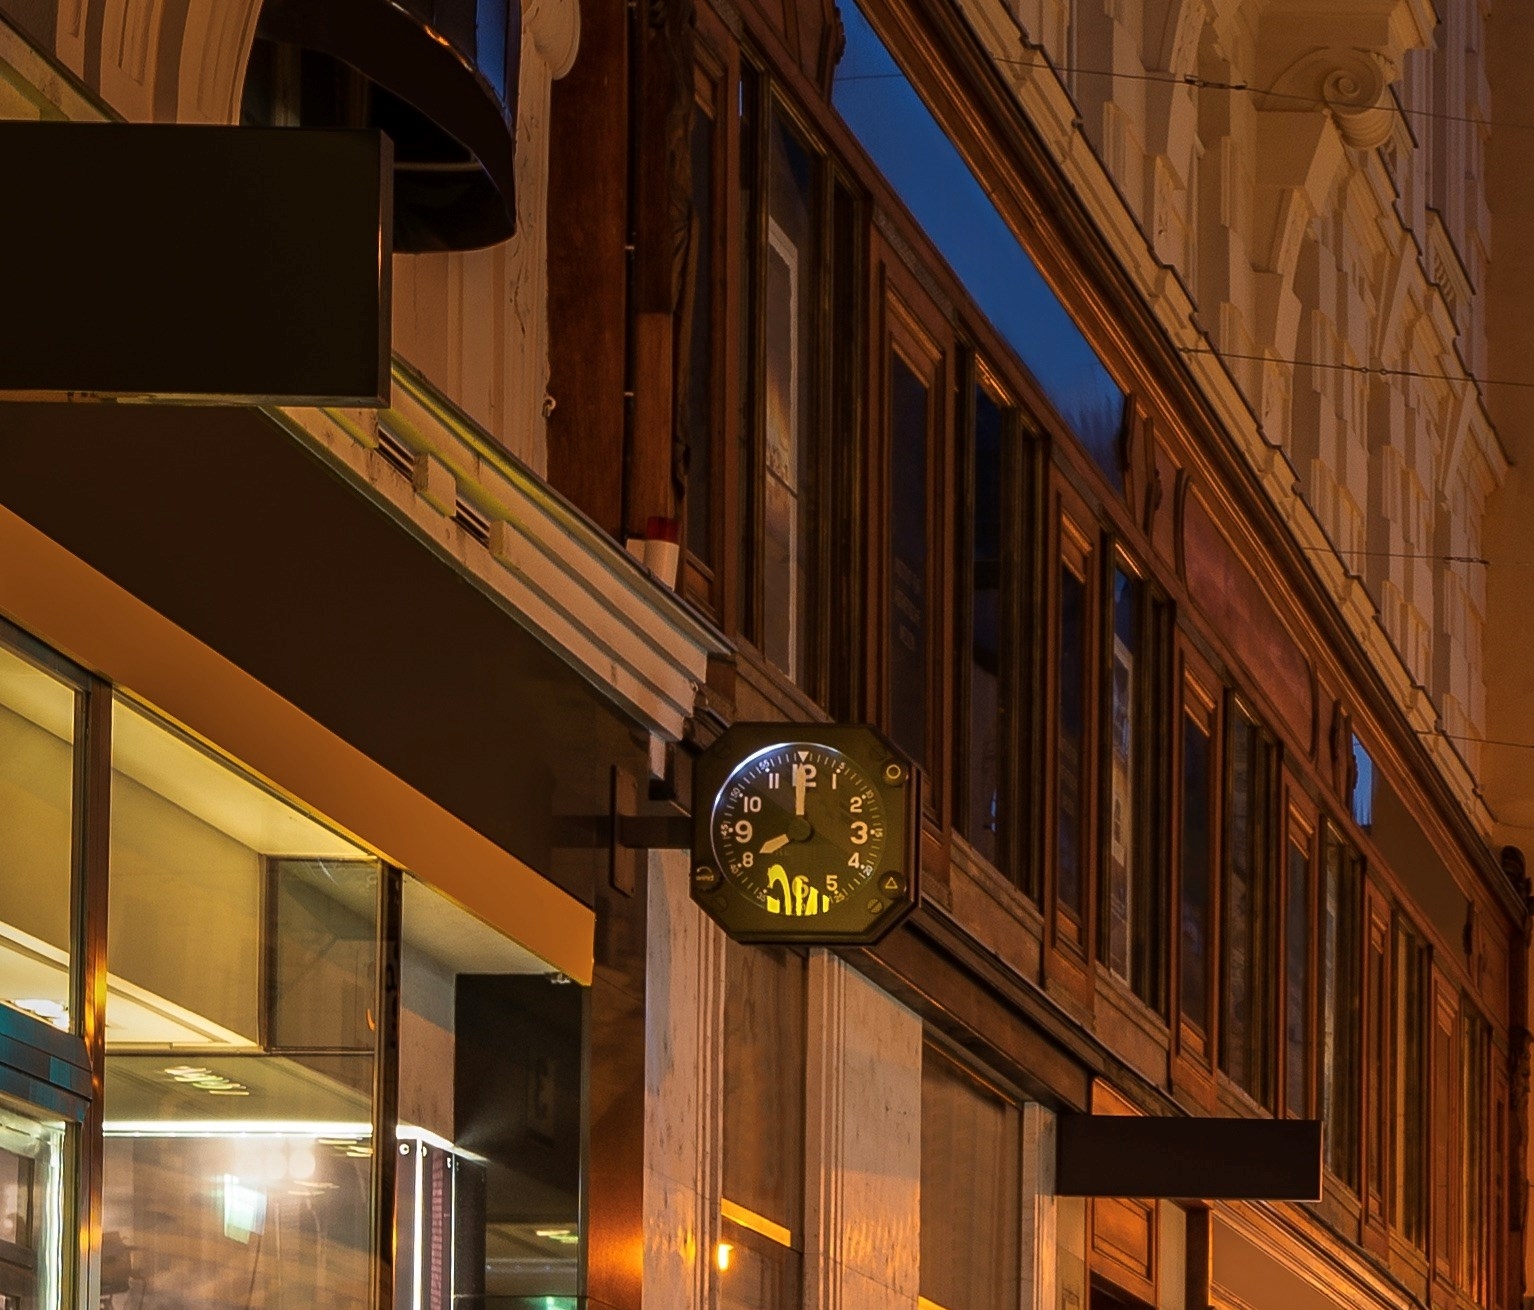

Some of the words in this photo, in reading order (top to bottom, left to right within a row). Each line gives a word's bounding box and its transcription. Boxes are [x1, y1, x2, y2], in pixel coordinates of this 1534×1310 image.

[768, 772, 780, 790] 11
[832, 773, 838, 790] 1
[744, 796, 762, 813] 10
[850, 796, 863, 814] 2
[735, 820, 753, 844] 9
[850, 820, 868, 845] 3
[742, 852, 754, 868] 8
[848, 852, 860, 868] 4
[826, 874, 838, 891] 5
